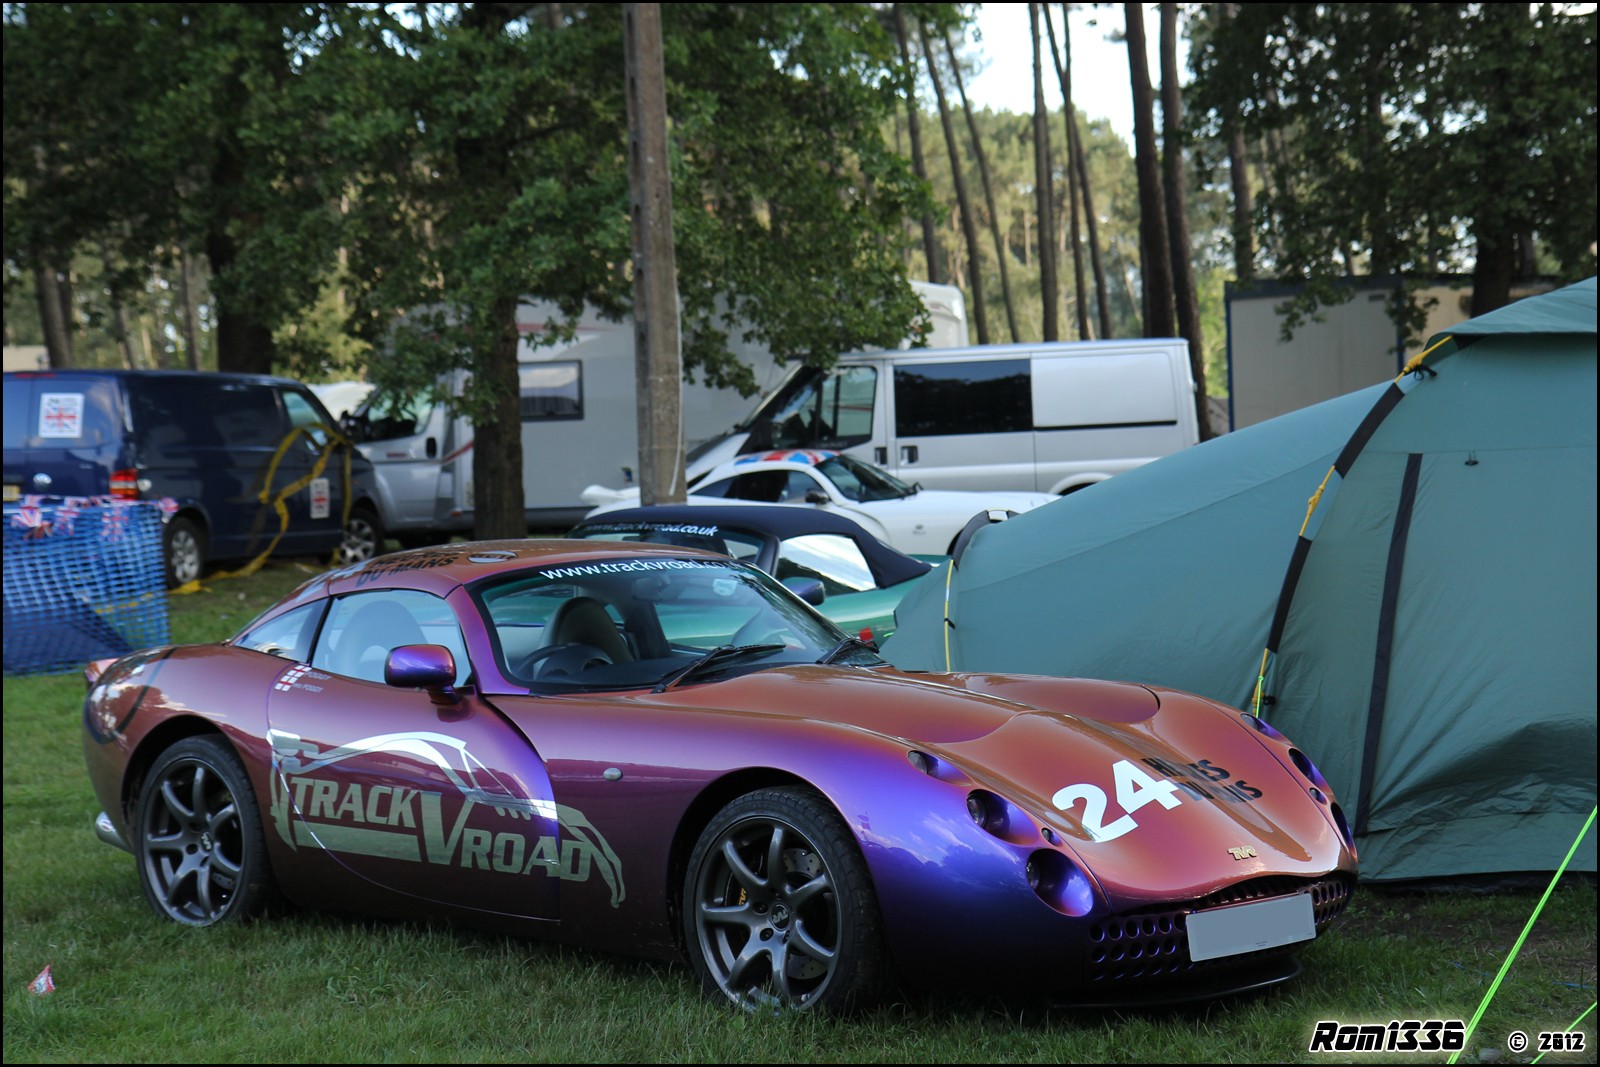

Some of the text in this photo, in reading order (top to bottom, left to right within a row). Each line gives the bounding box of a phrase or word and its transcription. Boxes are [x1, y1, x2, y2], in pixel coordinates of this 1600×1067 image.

[389, 557, 459, 576] MANS
[290, 777, 422, 828] TRACK
[1052, 759, 1182, 843] 24
[1228, 846, 1258, 860] TVR
